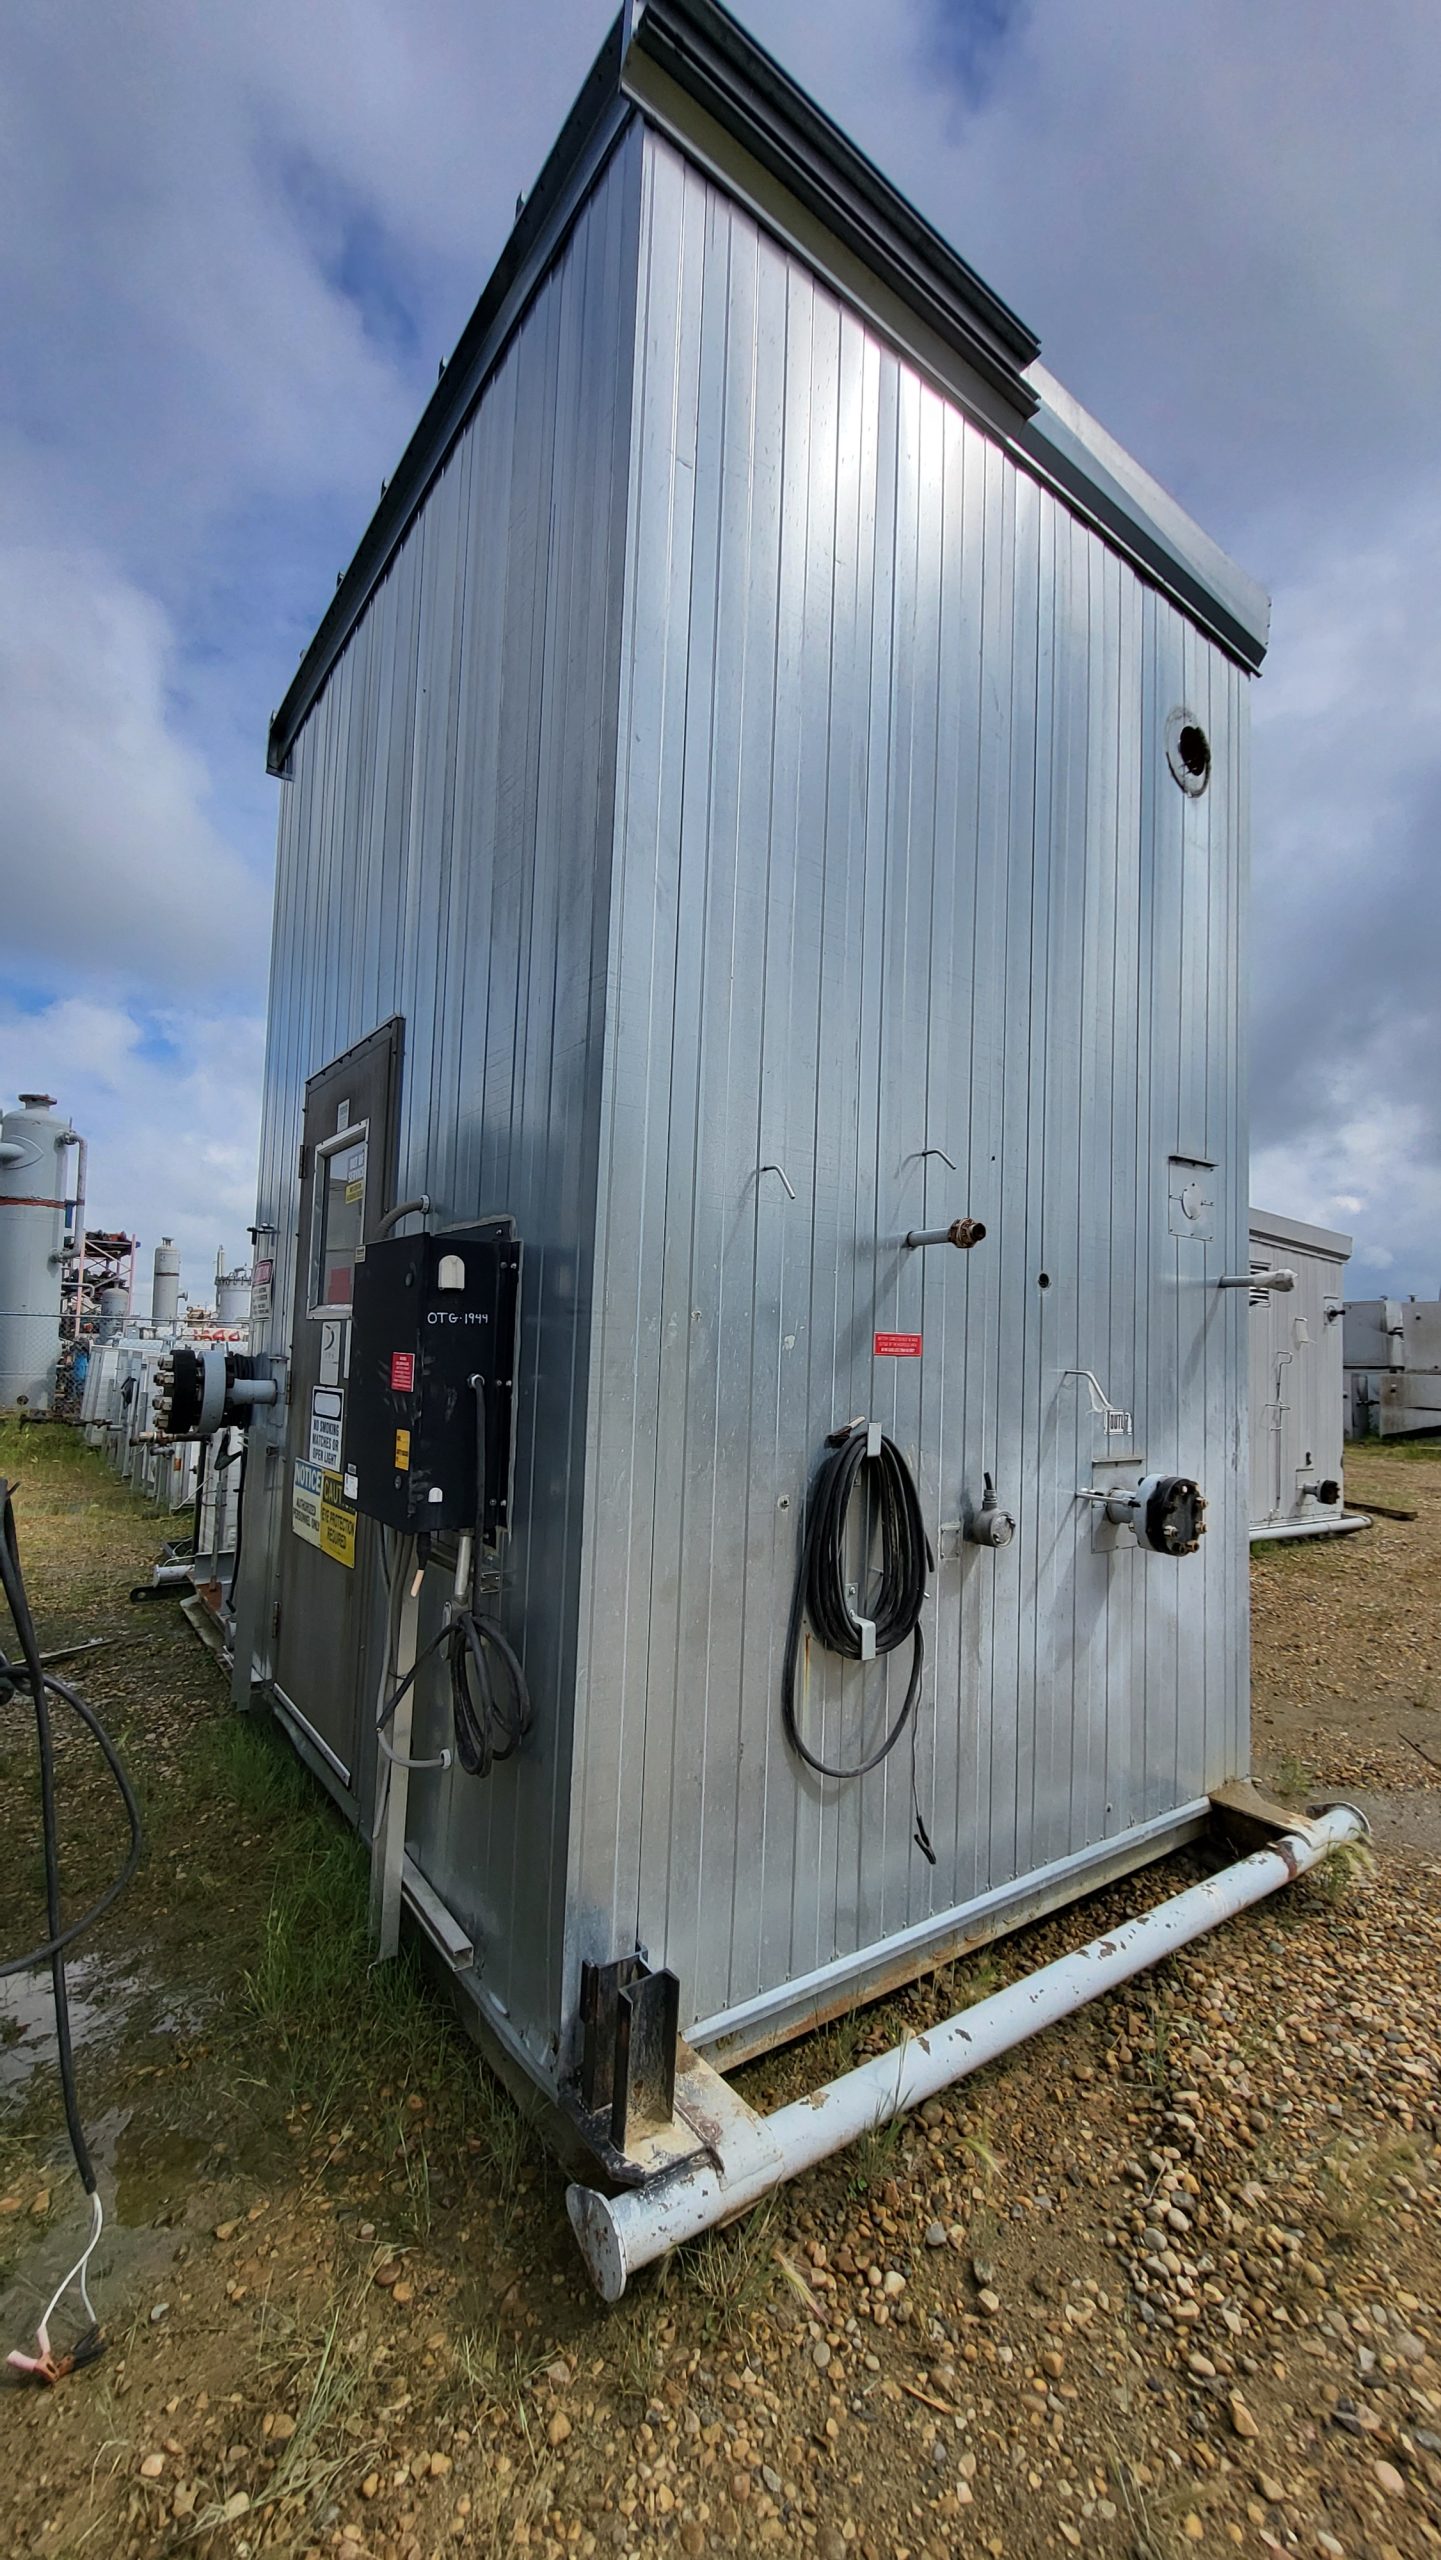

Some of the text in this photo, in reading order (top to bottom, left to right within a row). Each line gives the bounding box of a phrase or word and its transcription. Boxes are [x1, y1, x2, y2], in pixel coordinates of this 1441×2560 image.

[313, 1419, 340, 1437] NO SMOKING
[312, 1433, 339, 1452] MATCHES OR
[312, 1447, 337, 1467] OPEN LIGHT
[294, 1462, 322, 1493] NOTICE
